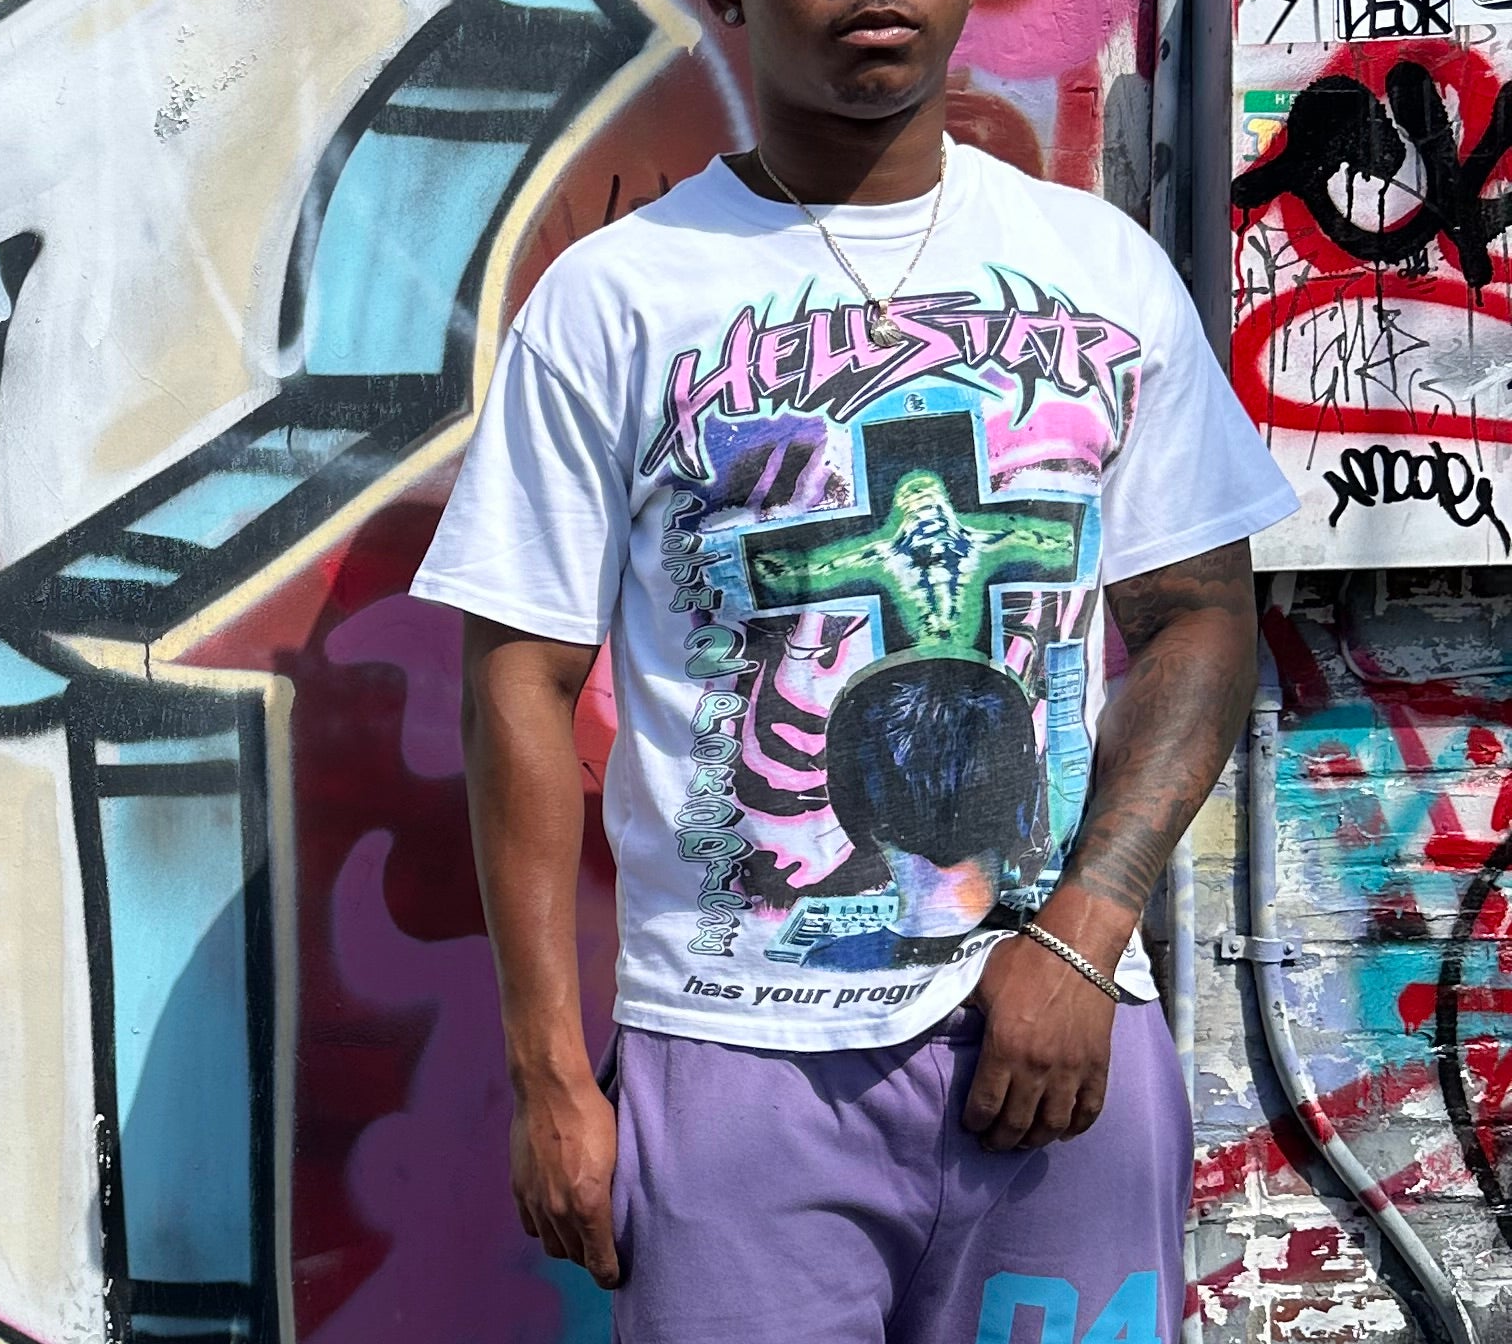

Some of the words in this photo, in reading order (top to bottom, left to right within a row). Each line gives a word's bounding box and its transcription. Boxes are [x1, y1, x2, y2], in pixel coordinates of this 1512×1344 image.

[684, 623, 759, 681] 2
[683, 975, 745, 1000] has
[752, 985, 831, 1006] your
